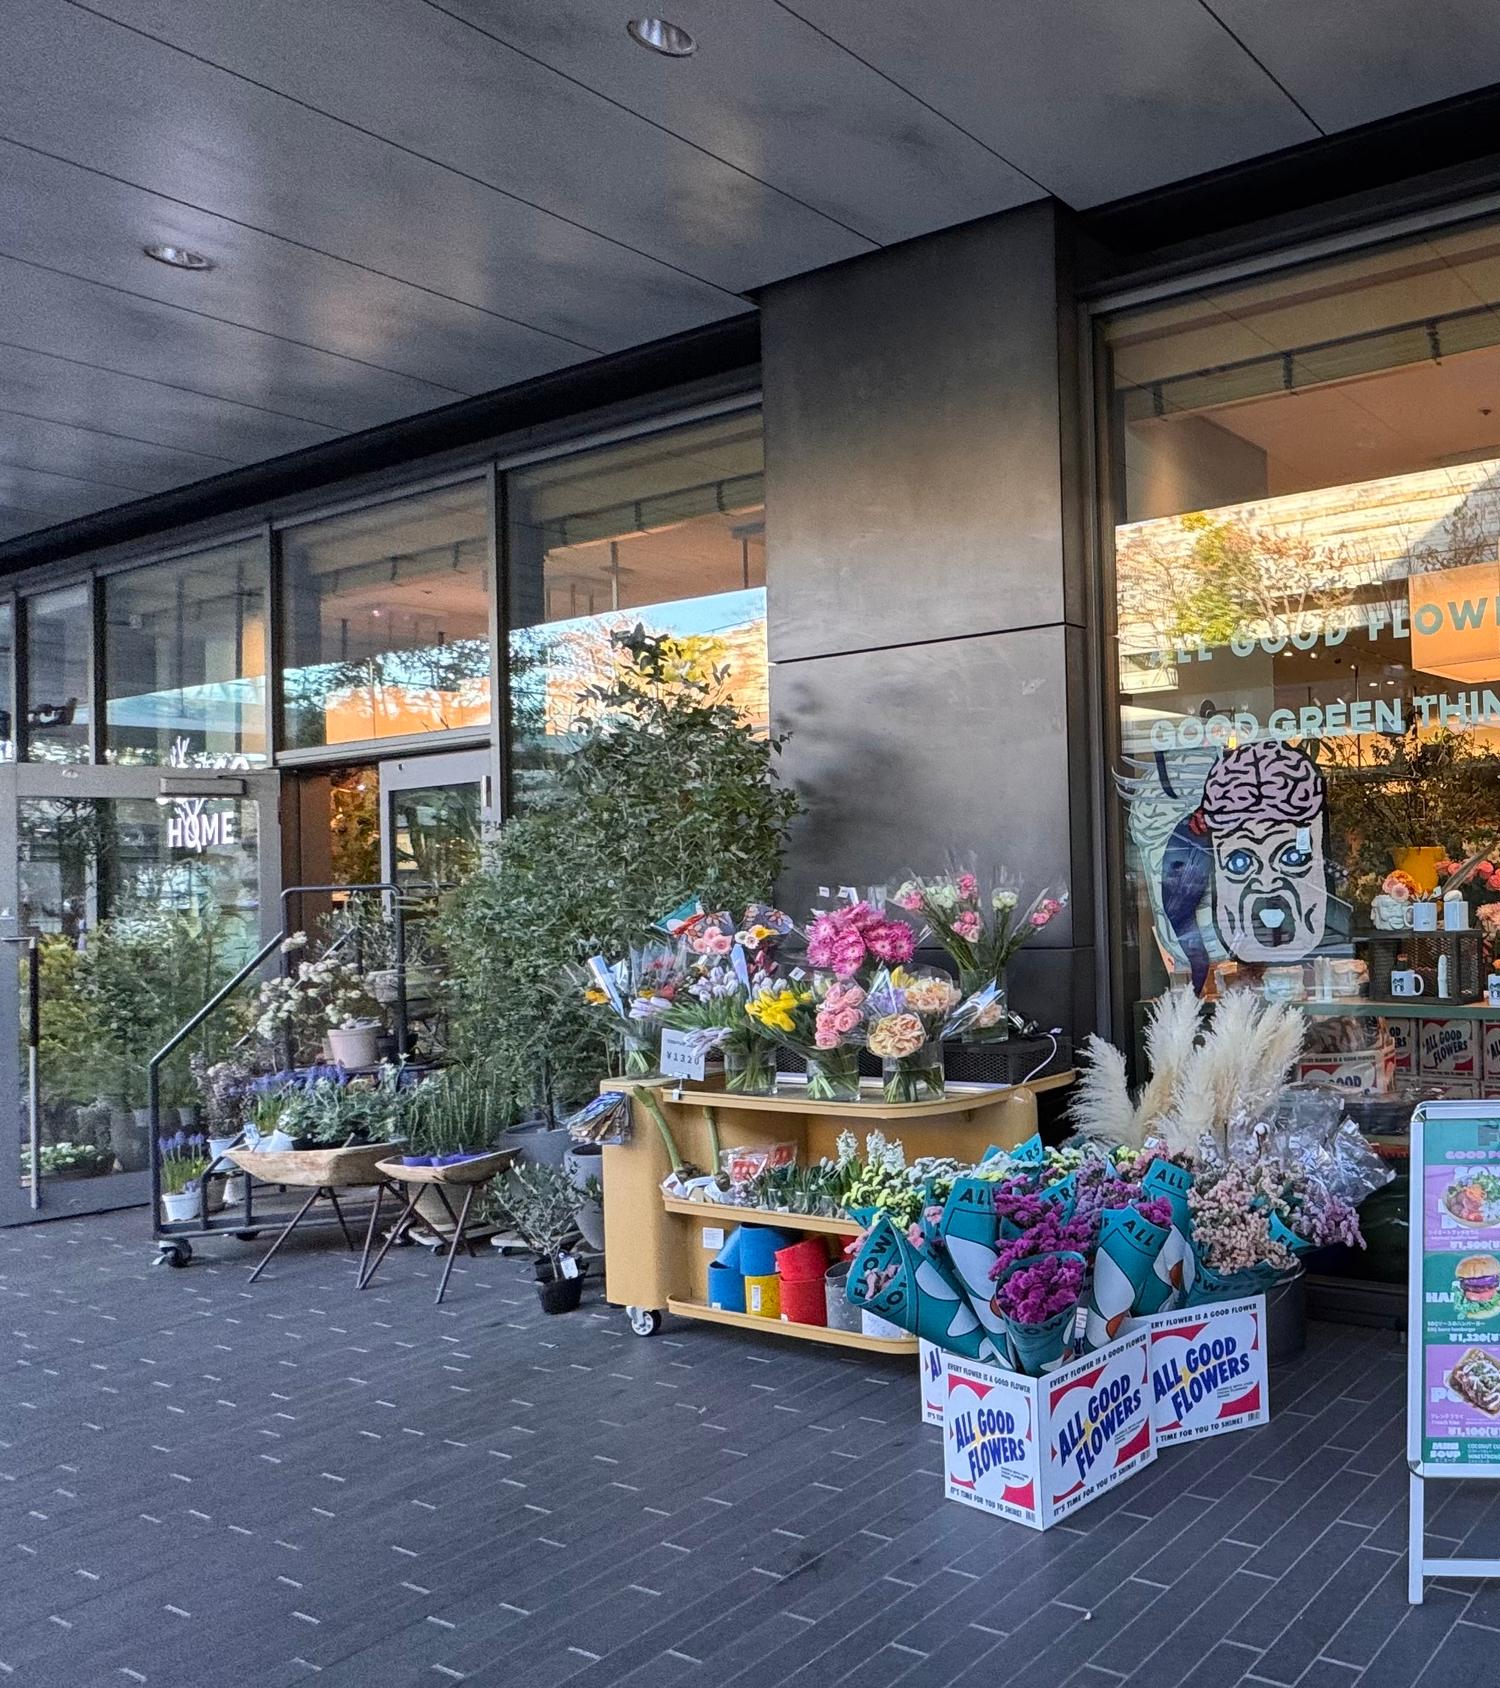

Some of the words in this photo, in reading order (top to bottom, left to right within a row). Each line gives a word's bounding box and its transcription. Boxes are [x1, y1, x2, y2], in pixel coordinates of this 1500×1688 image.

[1230, 614, 1347, 658] GOOD
[1149, 710, 1259, 751] GOOD
[1268, 698, 1407, 741] GREEN
[168, 811, 235, 849] HOME
[1425, 1033, 1439, 1055] ALL
[1439, 1029, 1462, 1044] GOOD
[1433, 1040, 1468, 1066] FLOWERS
[1154, 1168, 1184, 1189] ALL
[1123, 1218, 1156, 1247] ALL
[1151, 1321, 1164, 1329] ERY
[1166, 1316, 1192, 1326] FLOWER
[1210, 1308, 1230, 1318] GOOD
[1232, 1303, 1257, 1315] FLOWER
[1050, 1373, 1069, 1389] EVERY
[1070, 1362, 1094, 1378] FLOWER
[1108, 1346, 1124, 1359] GOOD
[1126, 1333, 1146, 1350] FLOWER
[1152, 1357, 1183, 1404] ALL
[1185, 1336, 1237, 1374] GOOD
[1171, 1353, 1250, 1422] FLOWERS
[955, 1411, 976, 1453] ALL
[977, 1408, 1015, 1437] GOOD
[1058, 1410, 1086, 1467] ALL
[1088, 1374, 1130, 1424] GOOD
[1075, 1388, 1142, 1481] FLOWERS
[1160, 1433, 1177, 1443] TIME
[1179, 1429, 1192, 1439] FOR
[1195, 1425, 1209, 1435] YOU
[1211, 1422, 1219, 1430] TO
[968, 1438, 1025, 1483] FLOWERS
[1066, 1494, 1082, 1508] TIME
[1083, 1487, 1095, 1500] FOR
[1096, 1477, 1108, 1490] YOU
[1110, 1471, 1117, 1481] TO
